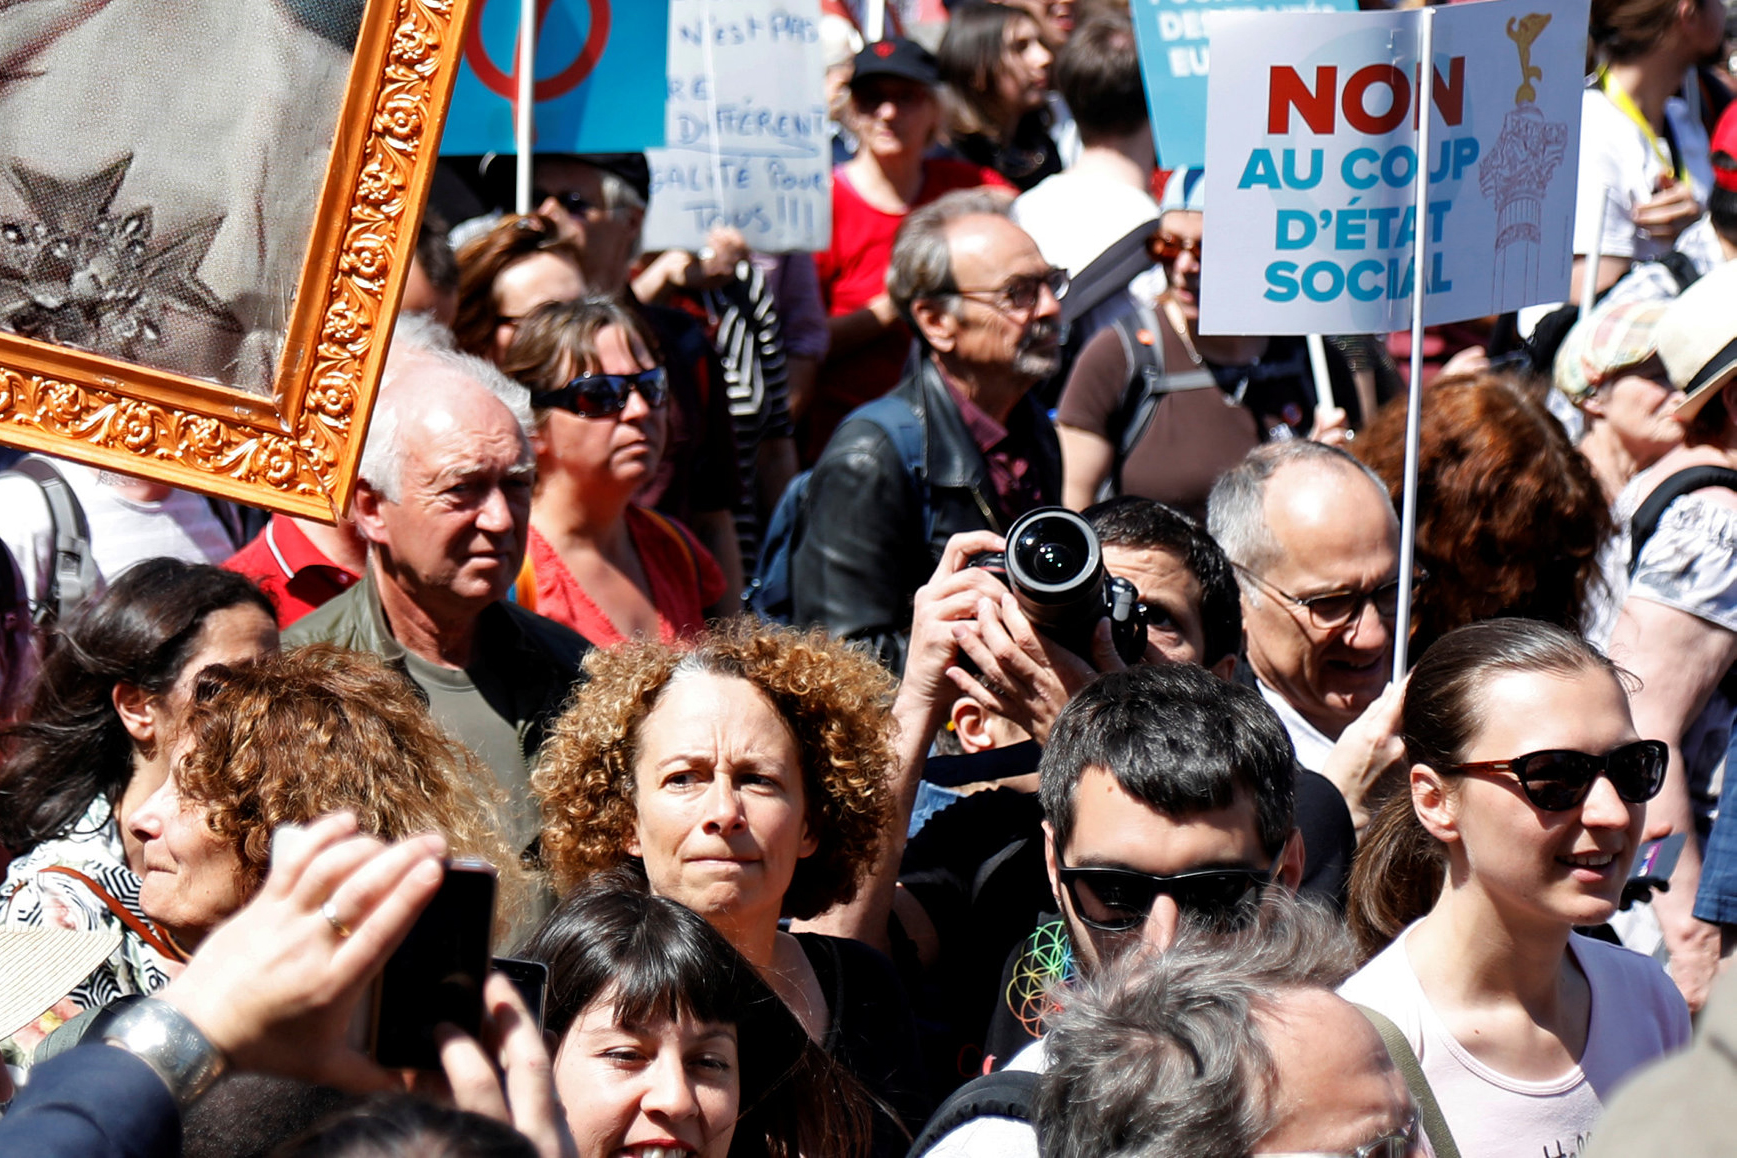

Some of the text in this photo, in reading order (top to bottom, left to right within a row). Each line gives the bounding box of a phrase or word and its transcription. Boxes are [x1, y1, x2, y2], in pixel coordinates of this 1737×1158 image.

[1266, 55, 1465, 137] NON
[1237, 136, 1480, 191] AU COUP
[1263, 252, 1453, 303] SOCIAL
